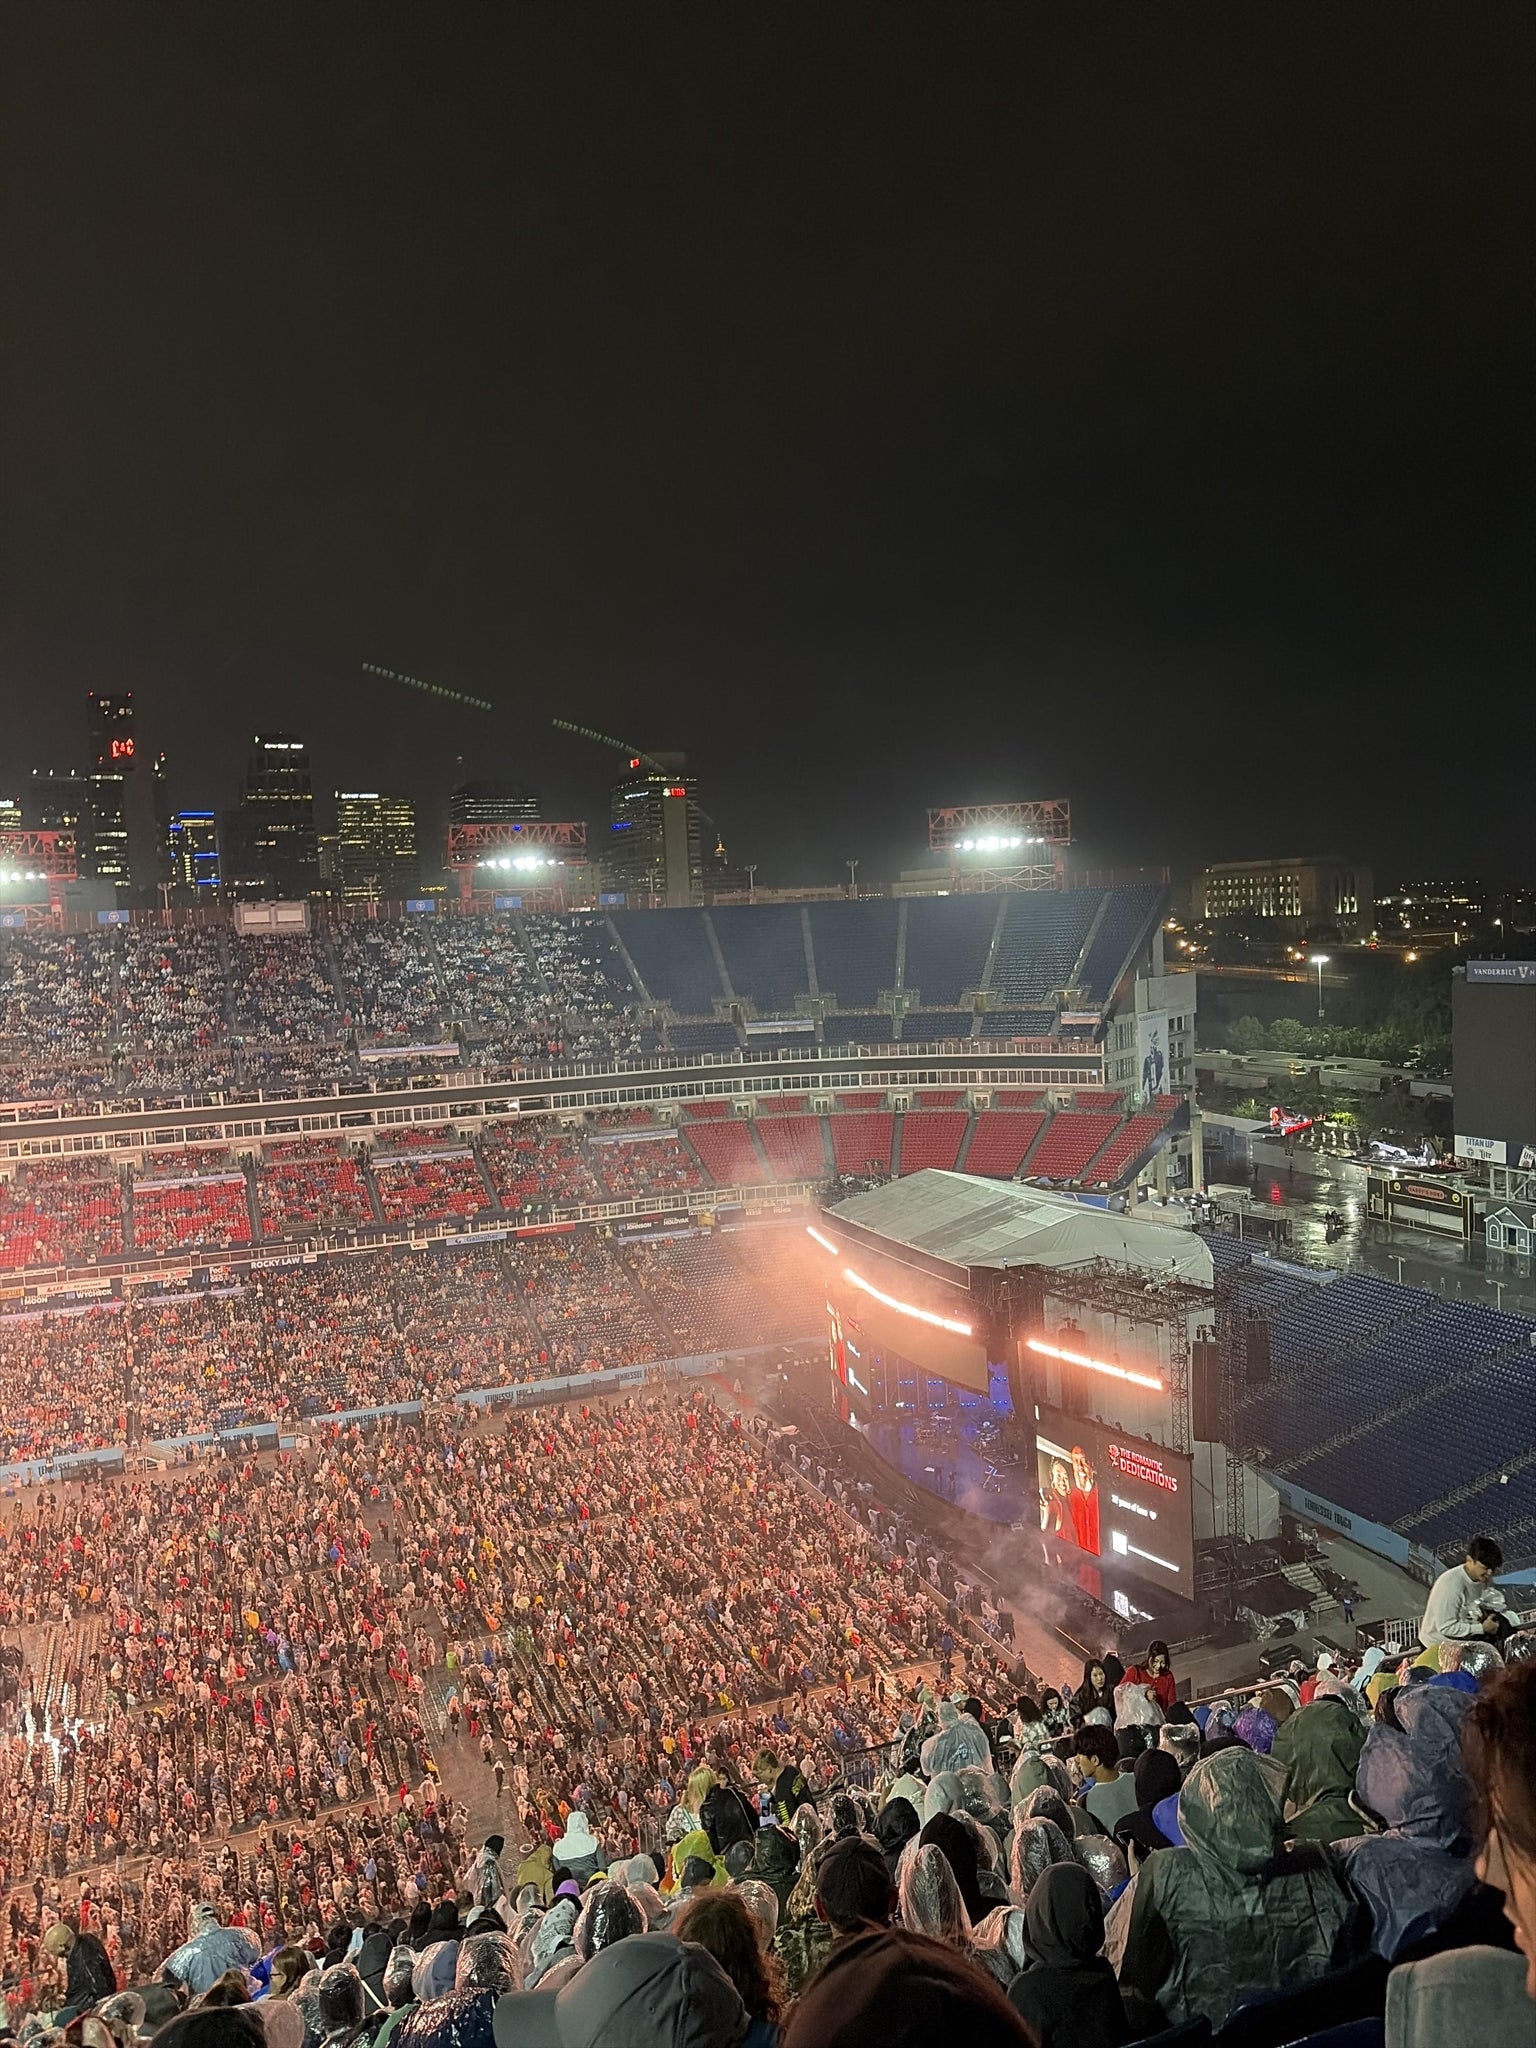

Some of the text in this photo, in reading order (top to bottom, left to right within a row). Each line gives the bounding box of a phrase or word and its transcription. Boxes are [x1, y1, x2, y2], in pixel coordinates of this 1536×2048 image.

[671, 788, 686, 798] UBS
[1474, 968, 1517, 977] VANDERBILT
[1465, 1137, 1495, 1149] TITAN UP
[466, 1233, 500, 1242] Gallagher
[251, 1258, 281, 1270] ROCKY
[281, 1256, 301, 1267] LAW
[209, 1266, 232, 1275] FedEx
[24, 1295, 48, 1306] MOON
[1120, 1447, 1163, 1472] THE ROMANTIC
[1119, 1457, 1178, 1493] DEDICATIONS
